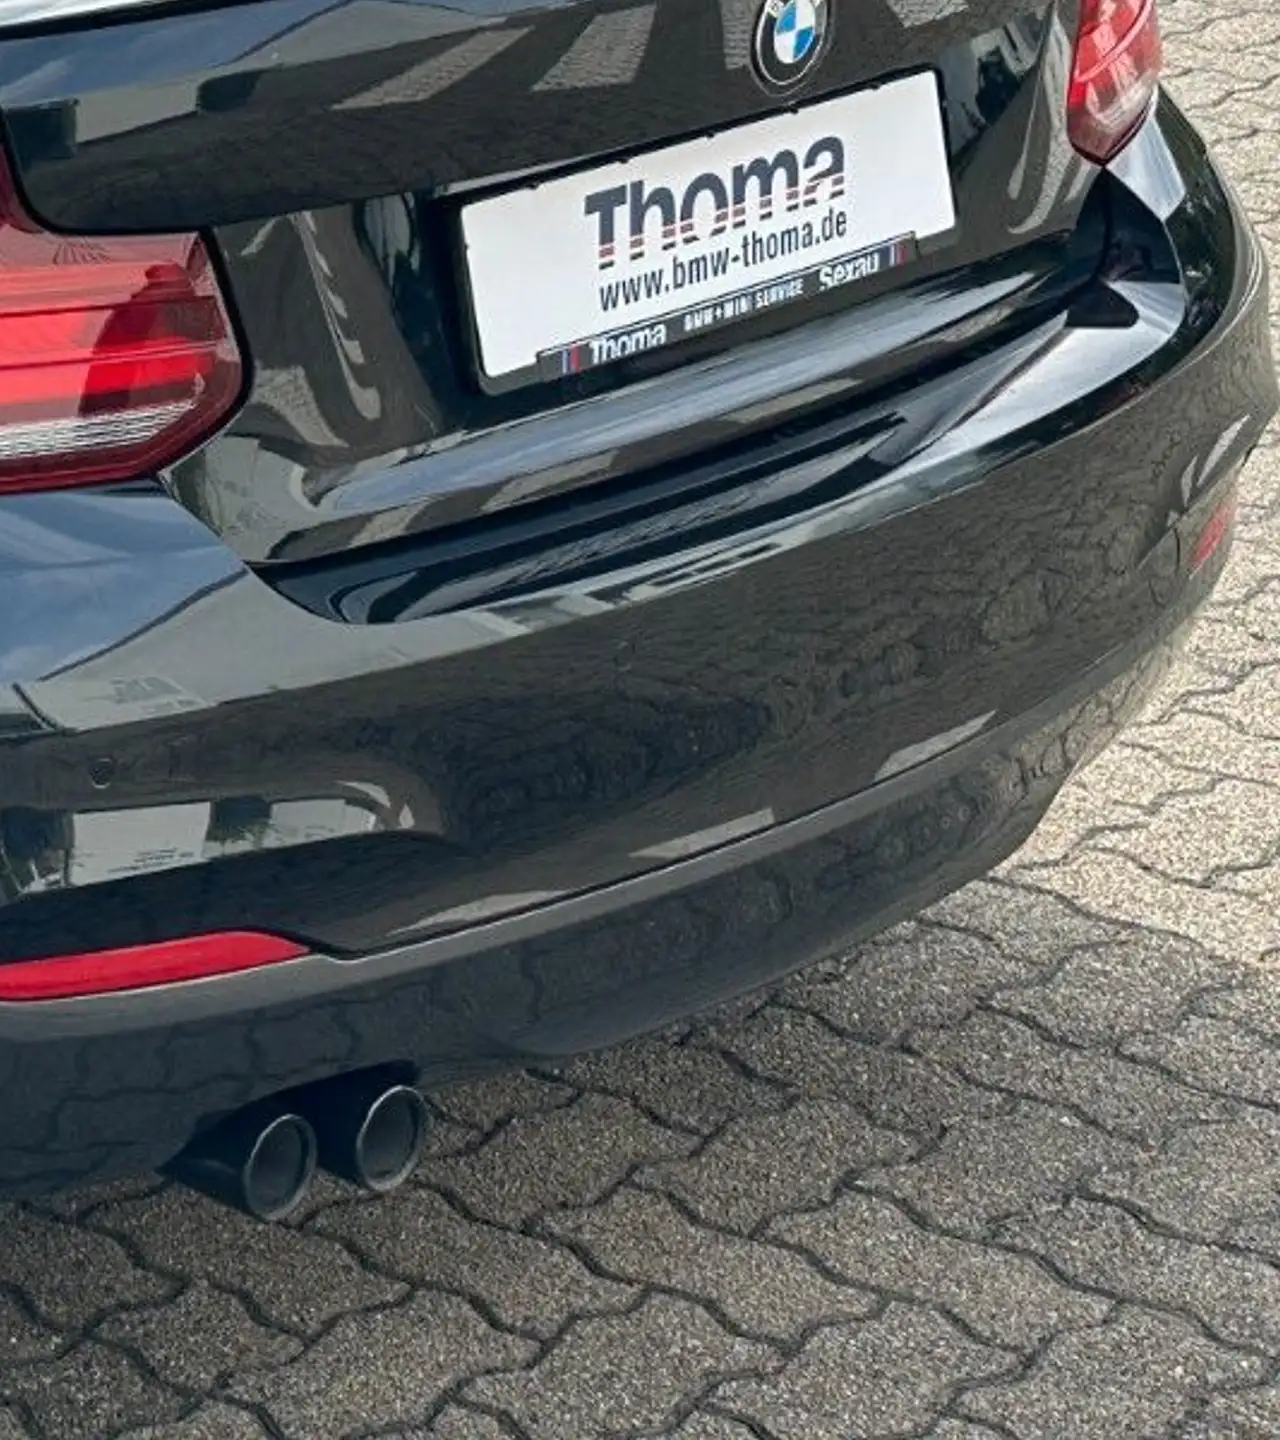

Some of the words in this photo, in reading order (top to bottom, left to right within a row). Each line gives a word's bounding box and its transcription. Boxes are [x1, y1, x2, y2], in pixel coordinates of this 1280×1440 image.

[584, 136, 845, 270] Thoma
[600, 207, 848, 312] www.bmw-thoma.de
[589, 322, 668, 366] Thoma
[818, 249, 881, 292] Sexau
